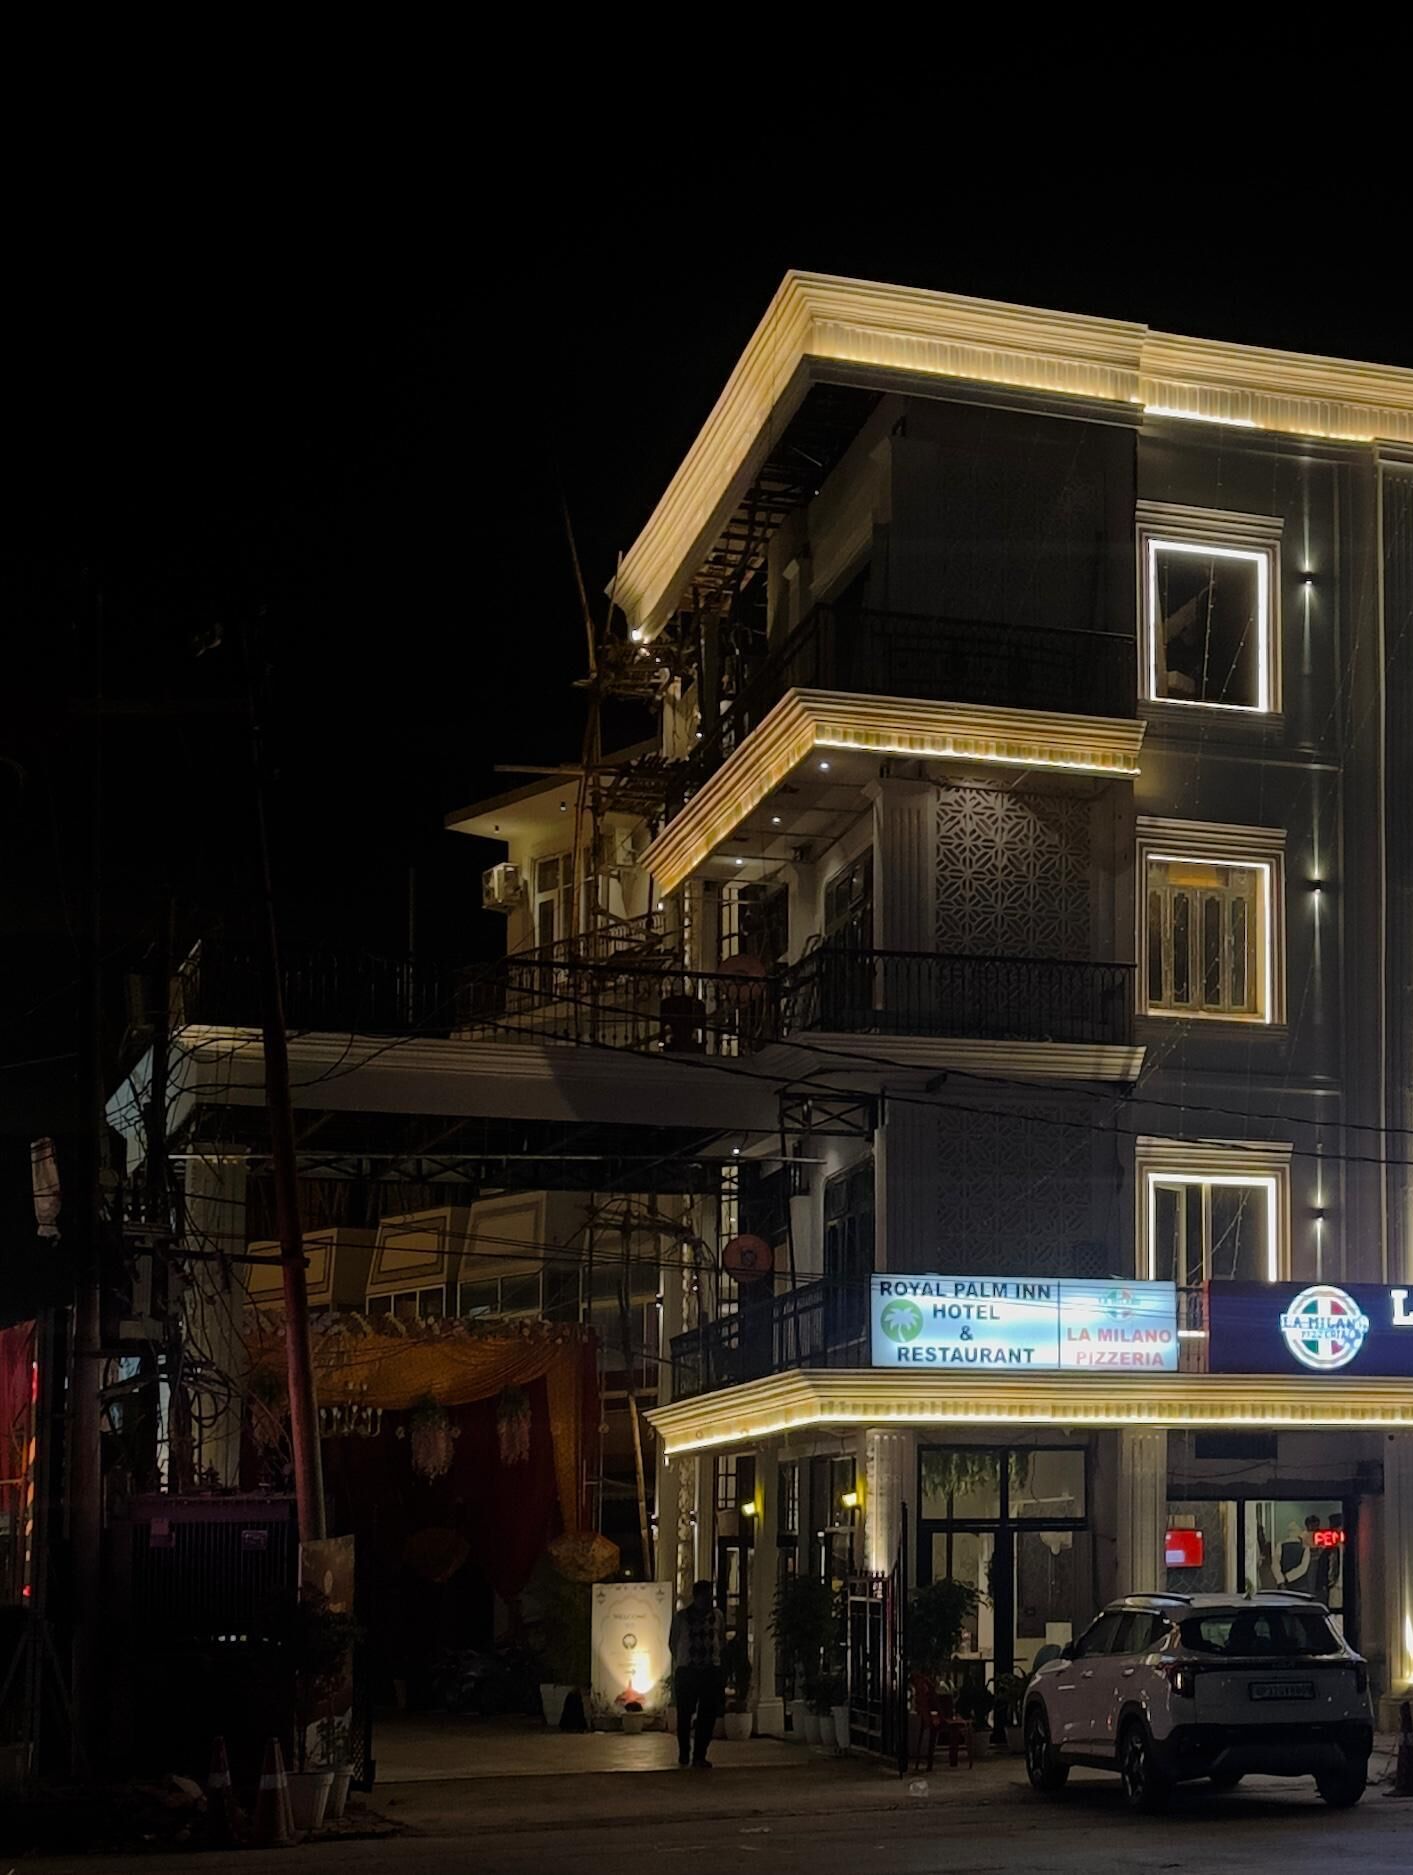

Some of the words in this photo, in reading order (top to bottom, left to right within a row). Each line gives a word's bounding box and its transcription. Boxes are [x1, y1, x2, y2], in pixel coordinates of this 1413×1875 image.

[880, 1280, 946, 1297] ROYAL
[954, 1282, 1008, 1299] PALM
[1016, 1283, 1051, 1299] INN
[933, 1303, 1000, 1320] HOTEL
[1283, 1316, 1301, 1328] LA
[959, 1326, 973, 1341] &
[1067, 1327, 1090, 1342] LA
[1097, 1328, 1171, 1344] MILANO
[897, 1346, 1036, 1364] RESTAURANT
[1076, 1351, 1164, 1367] PIZZERIA
